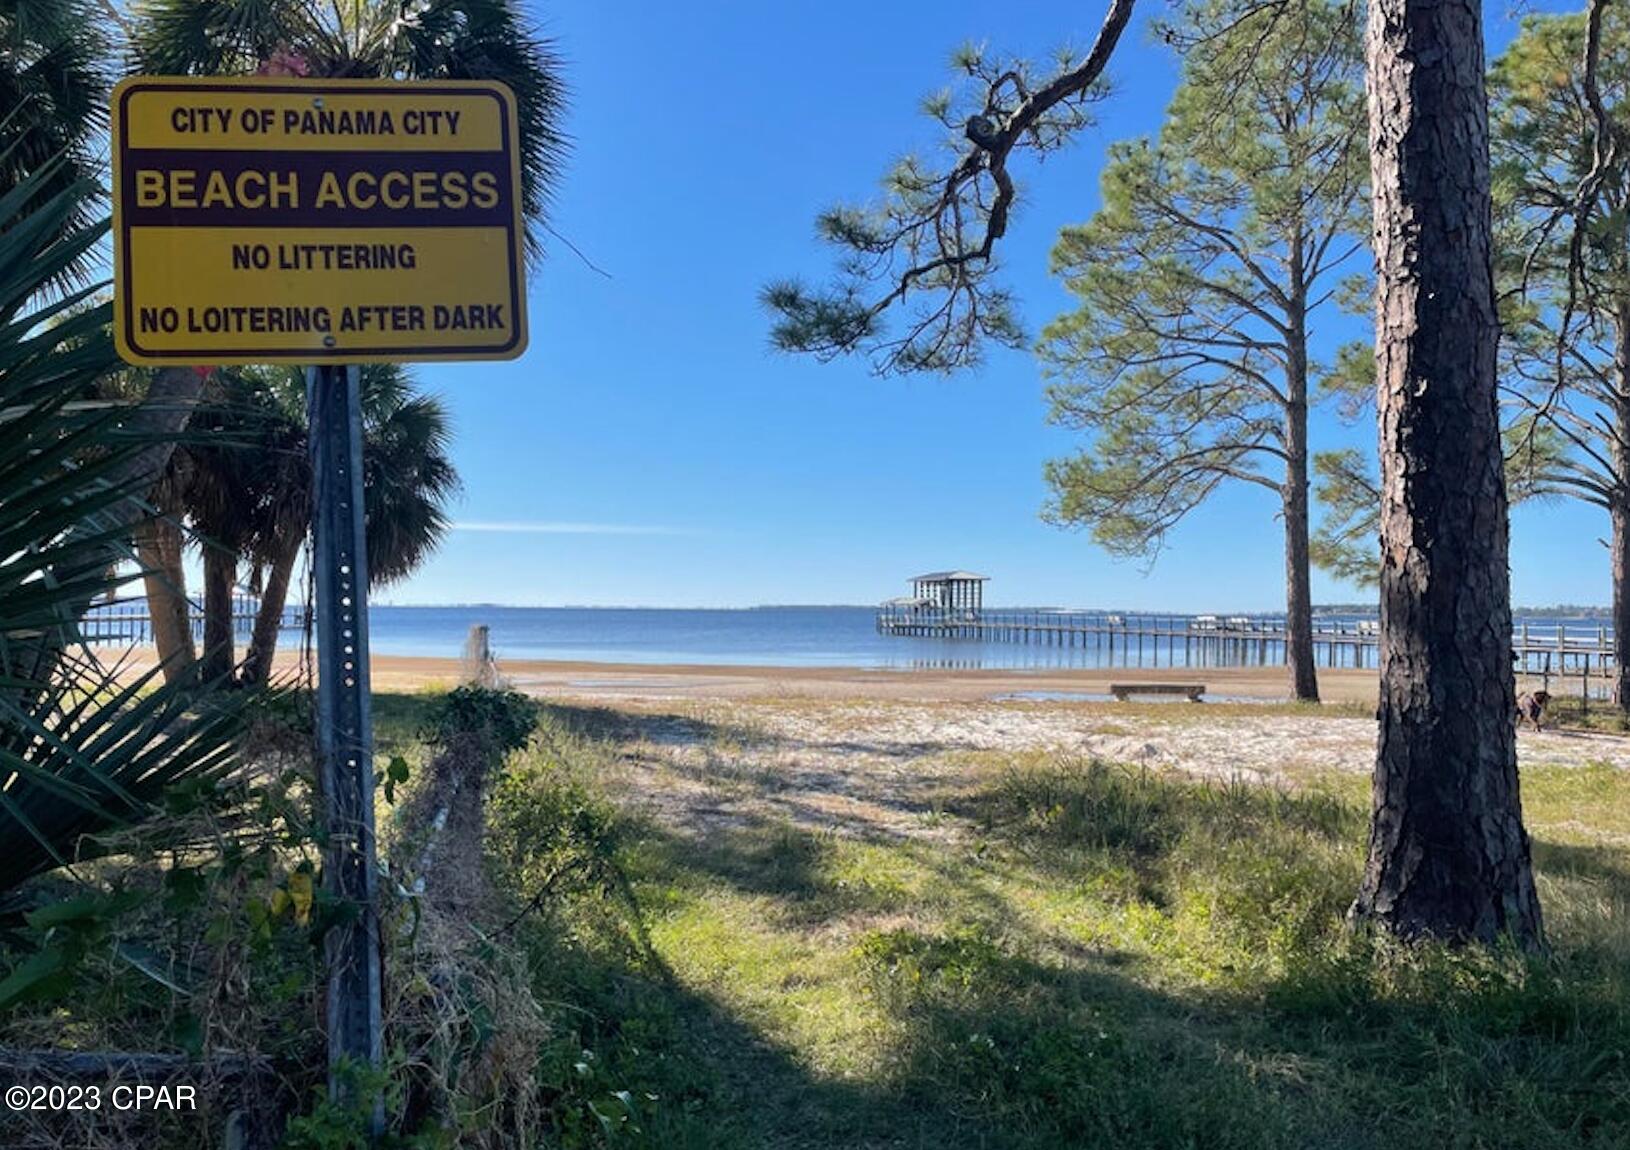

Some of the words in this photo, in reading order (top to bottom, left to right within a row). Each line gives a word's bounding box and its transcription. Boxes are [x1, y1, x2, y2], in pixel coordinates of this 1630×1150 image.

[171, 108, 232, 134] CITY
[241, 108, 275, 134] OF
[284, 109, 395, 135] PANAMA
[403, 110, 460, 136] CITY
[135, 169, 299, 209] BEACH
[315, 170, 499, 209] ACCESS
[232, 244, 270, 269] NO
[279, 244, 416, 269] LITTERING
[141, 306, 179, 333] NO
[188, 306, 331, 333] LOITERING
[340, 305, 425, 332] AFTER
[434, 304, 504, 330] DARK
